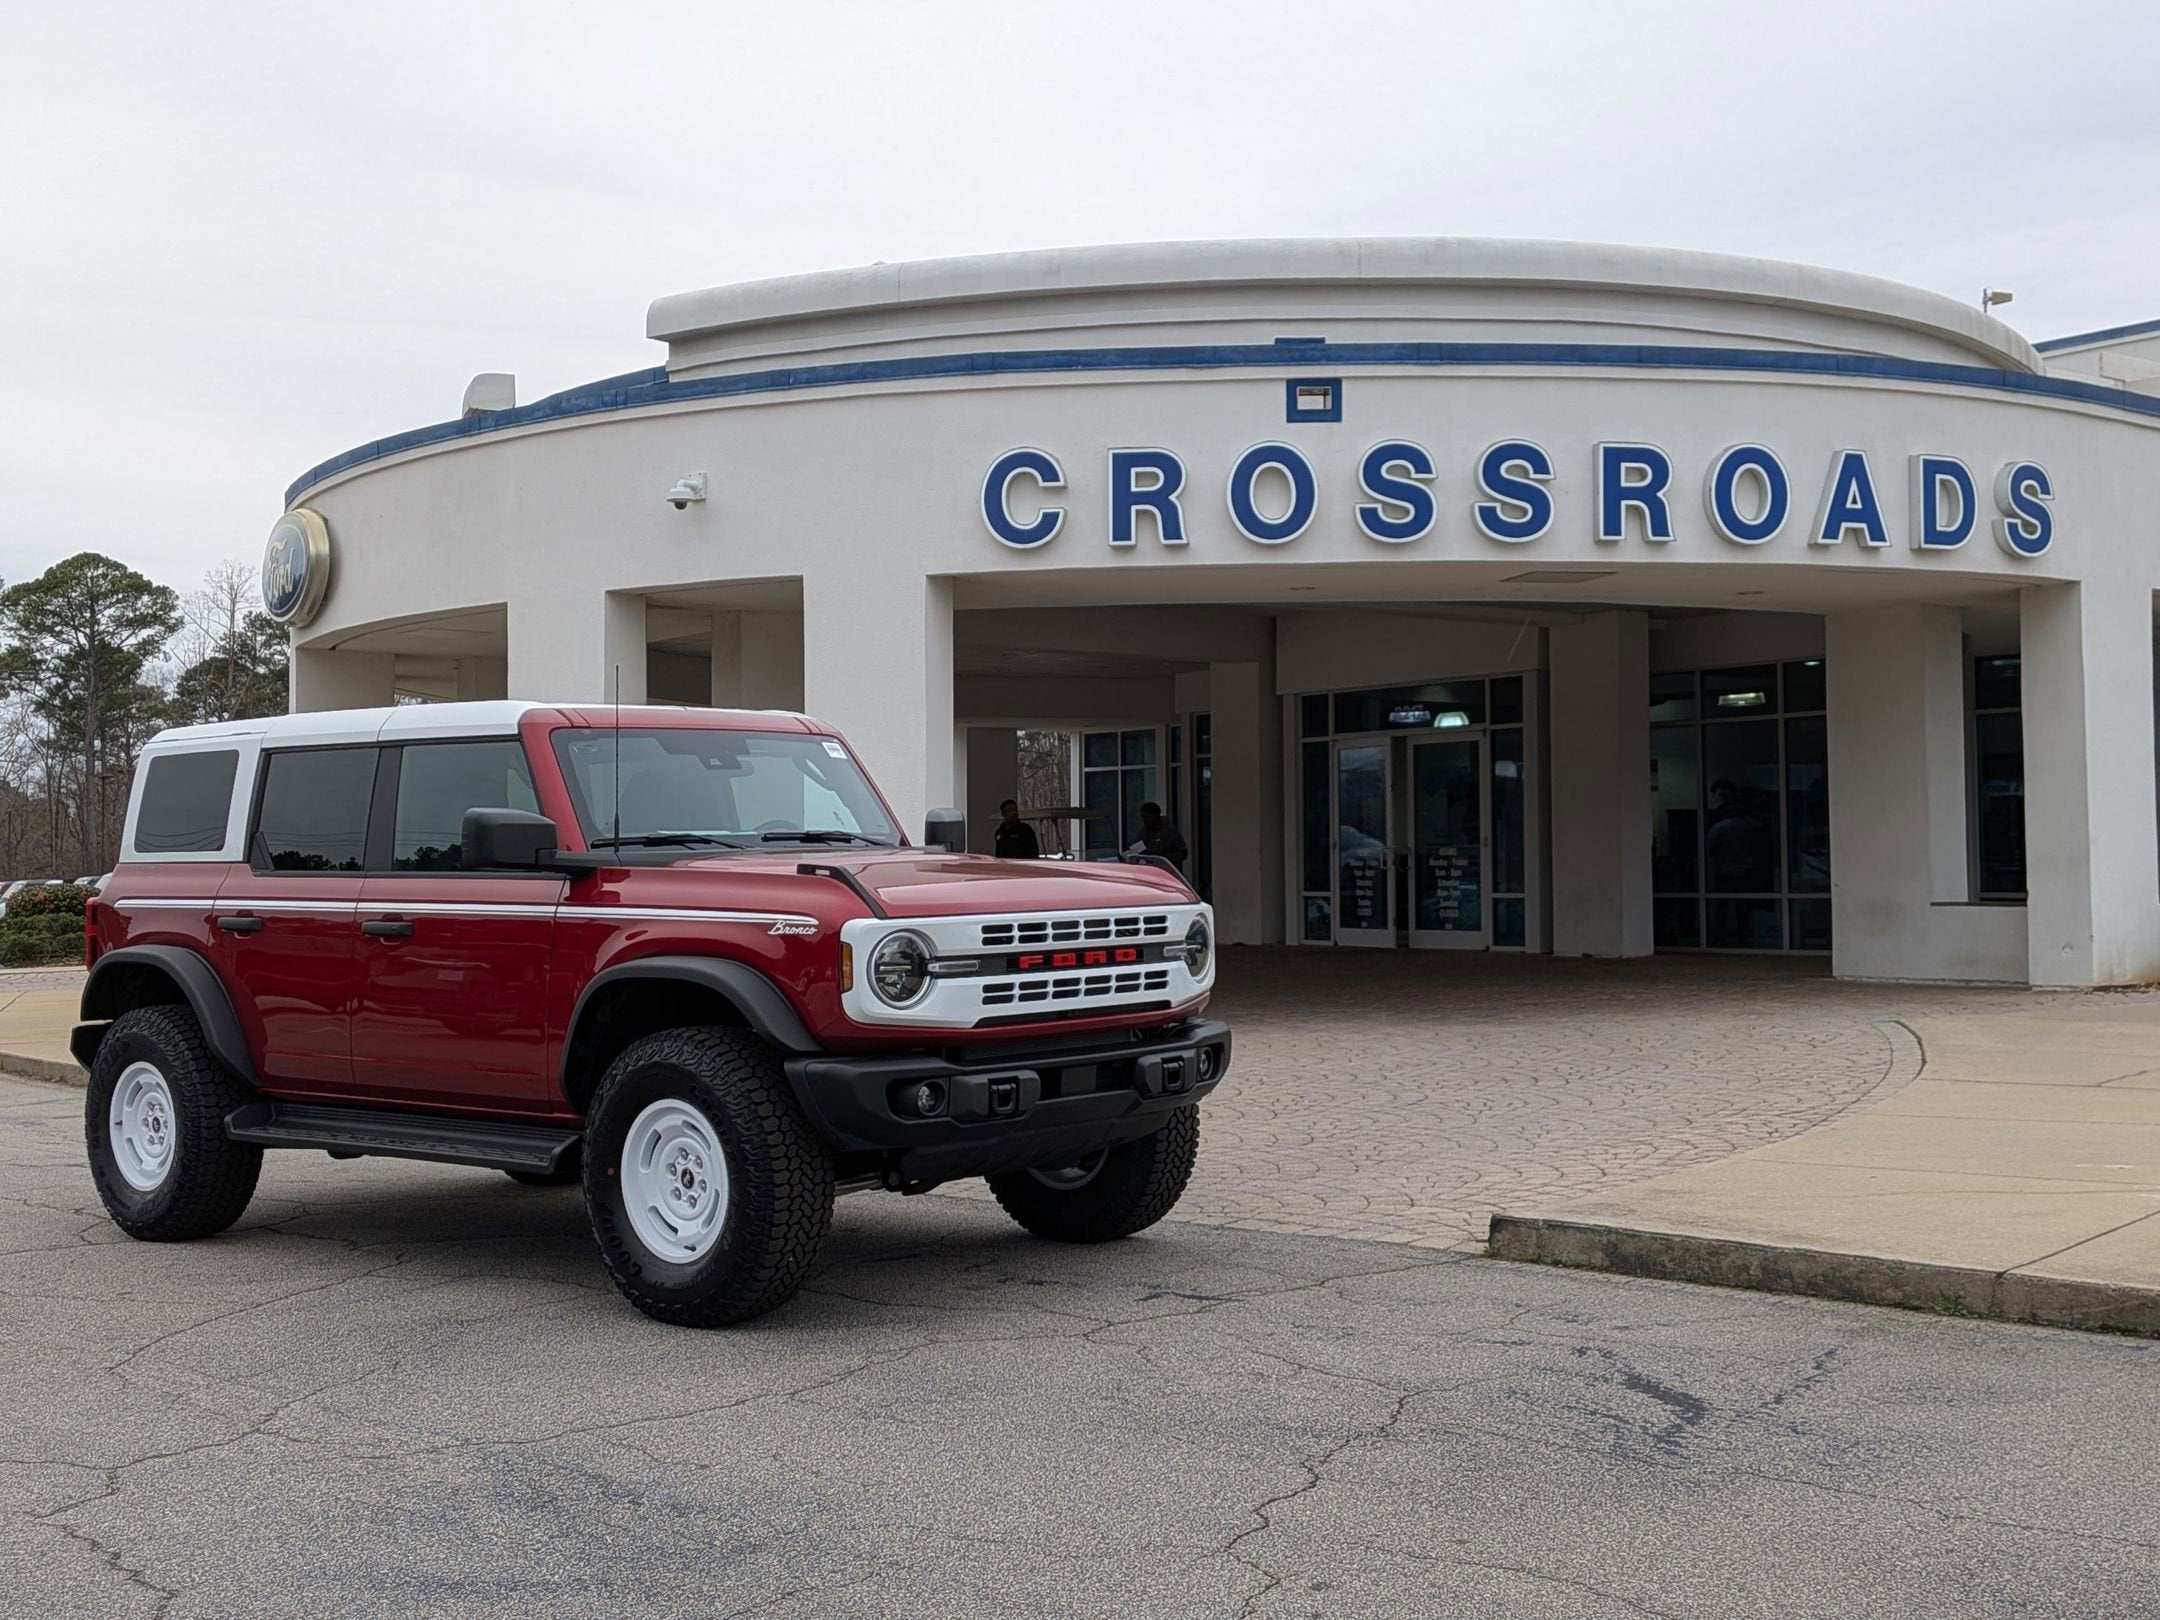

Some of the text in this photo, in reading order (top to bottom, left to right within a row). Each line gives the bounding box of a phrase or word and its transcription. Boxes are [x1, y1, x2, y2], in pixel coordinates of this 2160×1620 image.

[980, 440, 2055, 559] CROSSROADS
[267, 538, 296, 603] Ford
[767, 919, 818, 935] Bronco
[1019, 948, 1137, 969] FORD
